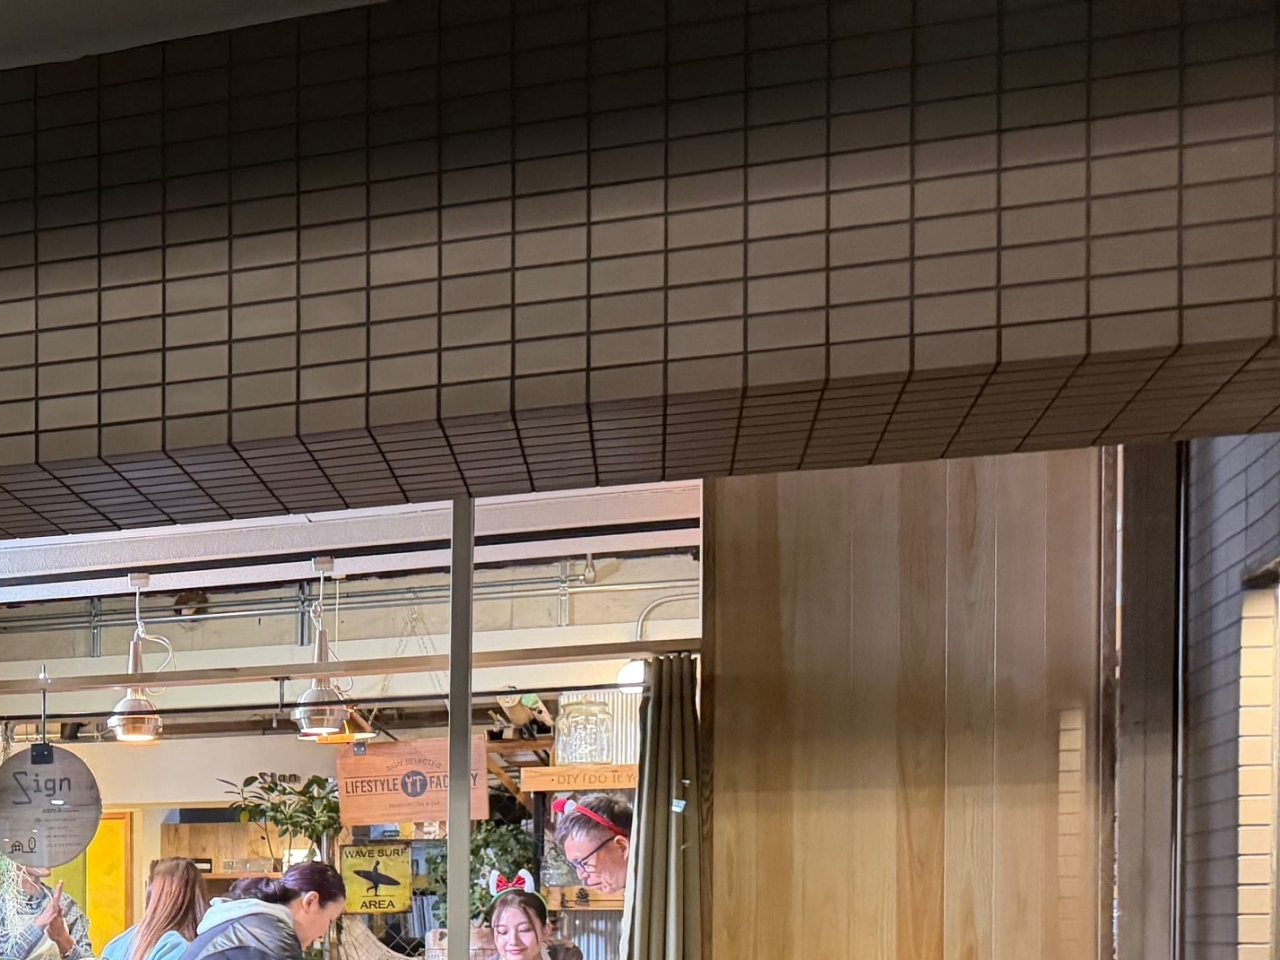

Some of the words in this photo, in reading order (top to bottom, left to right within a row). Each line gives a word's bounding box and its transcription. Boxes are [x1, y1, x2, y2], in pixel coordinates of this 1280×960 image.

[12, 771, 71, 805] Sign
[345, 777, 399, 794] LIFESTYLE
[429, 773, 479, 789] FACY
[345, 850, 374, 858] WAVE
[378, 849, 406, 857] SURF
[360, 900, 395, 909] AREA
